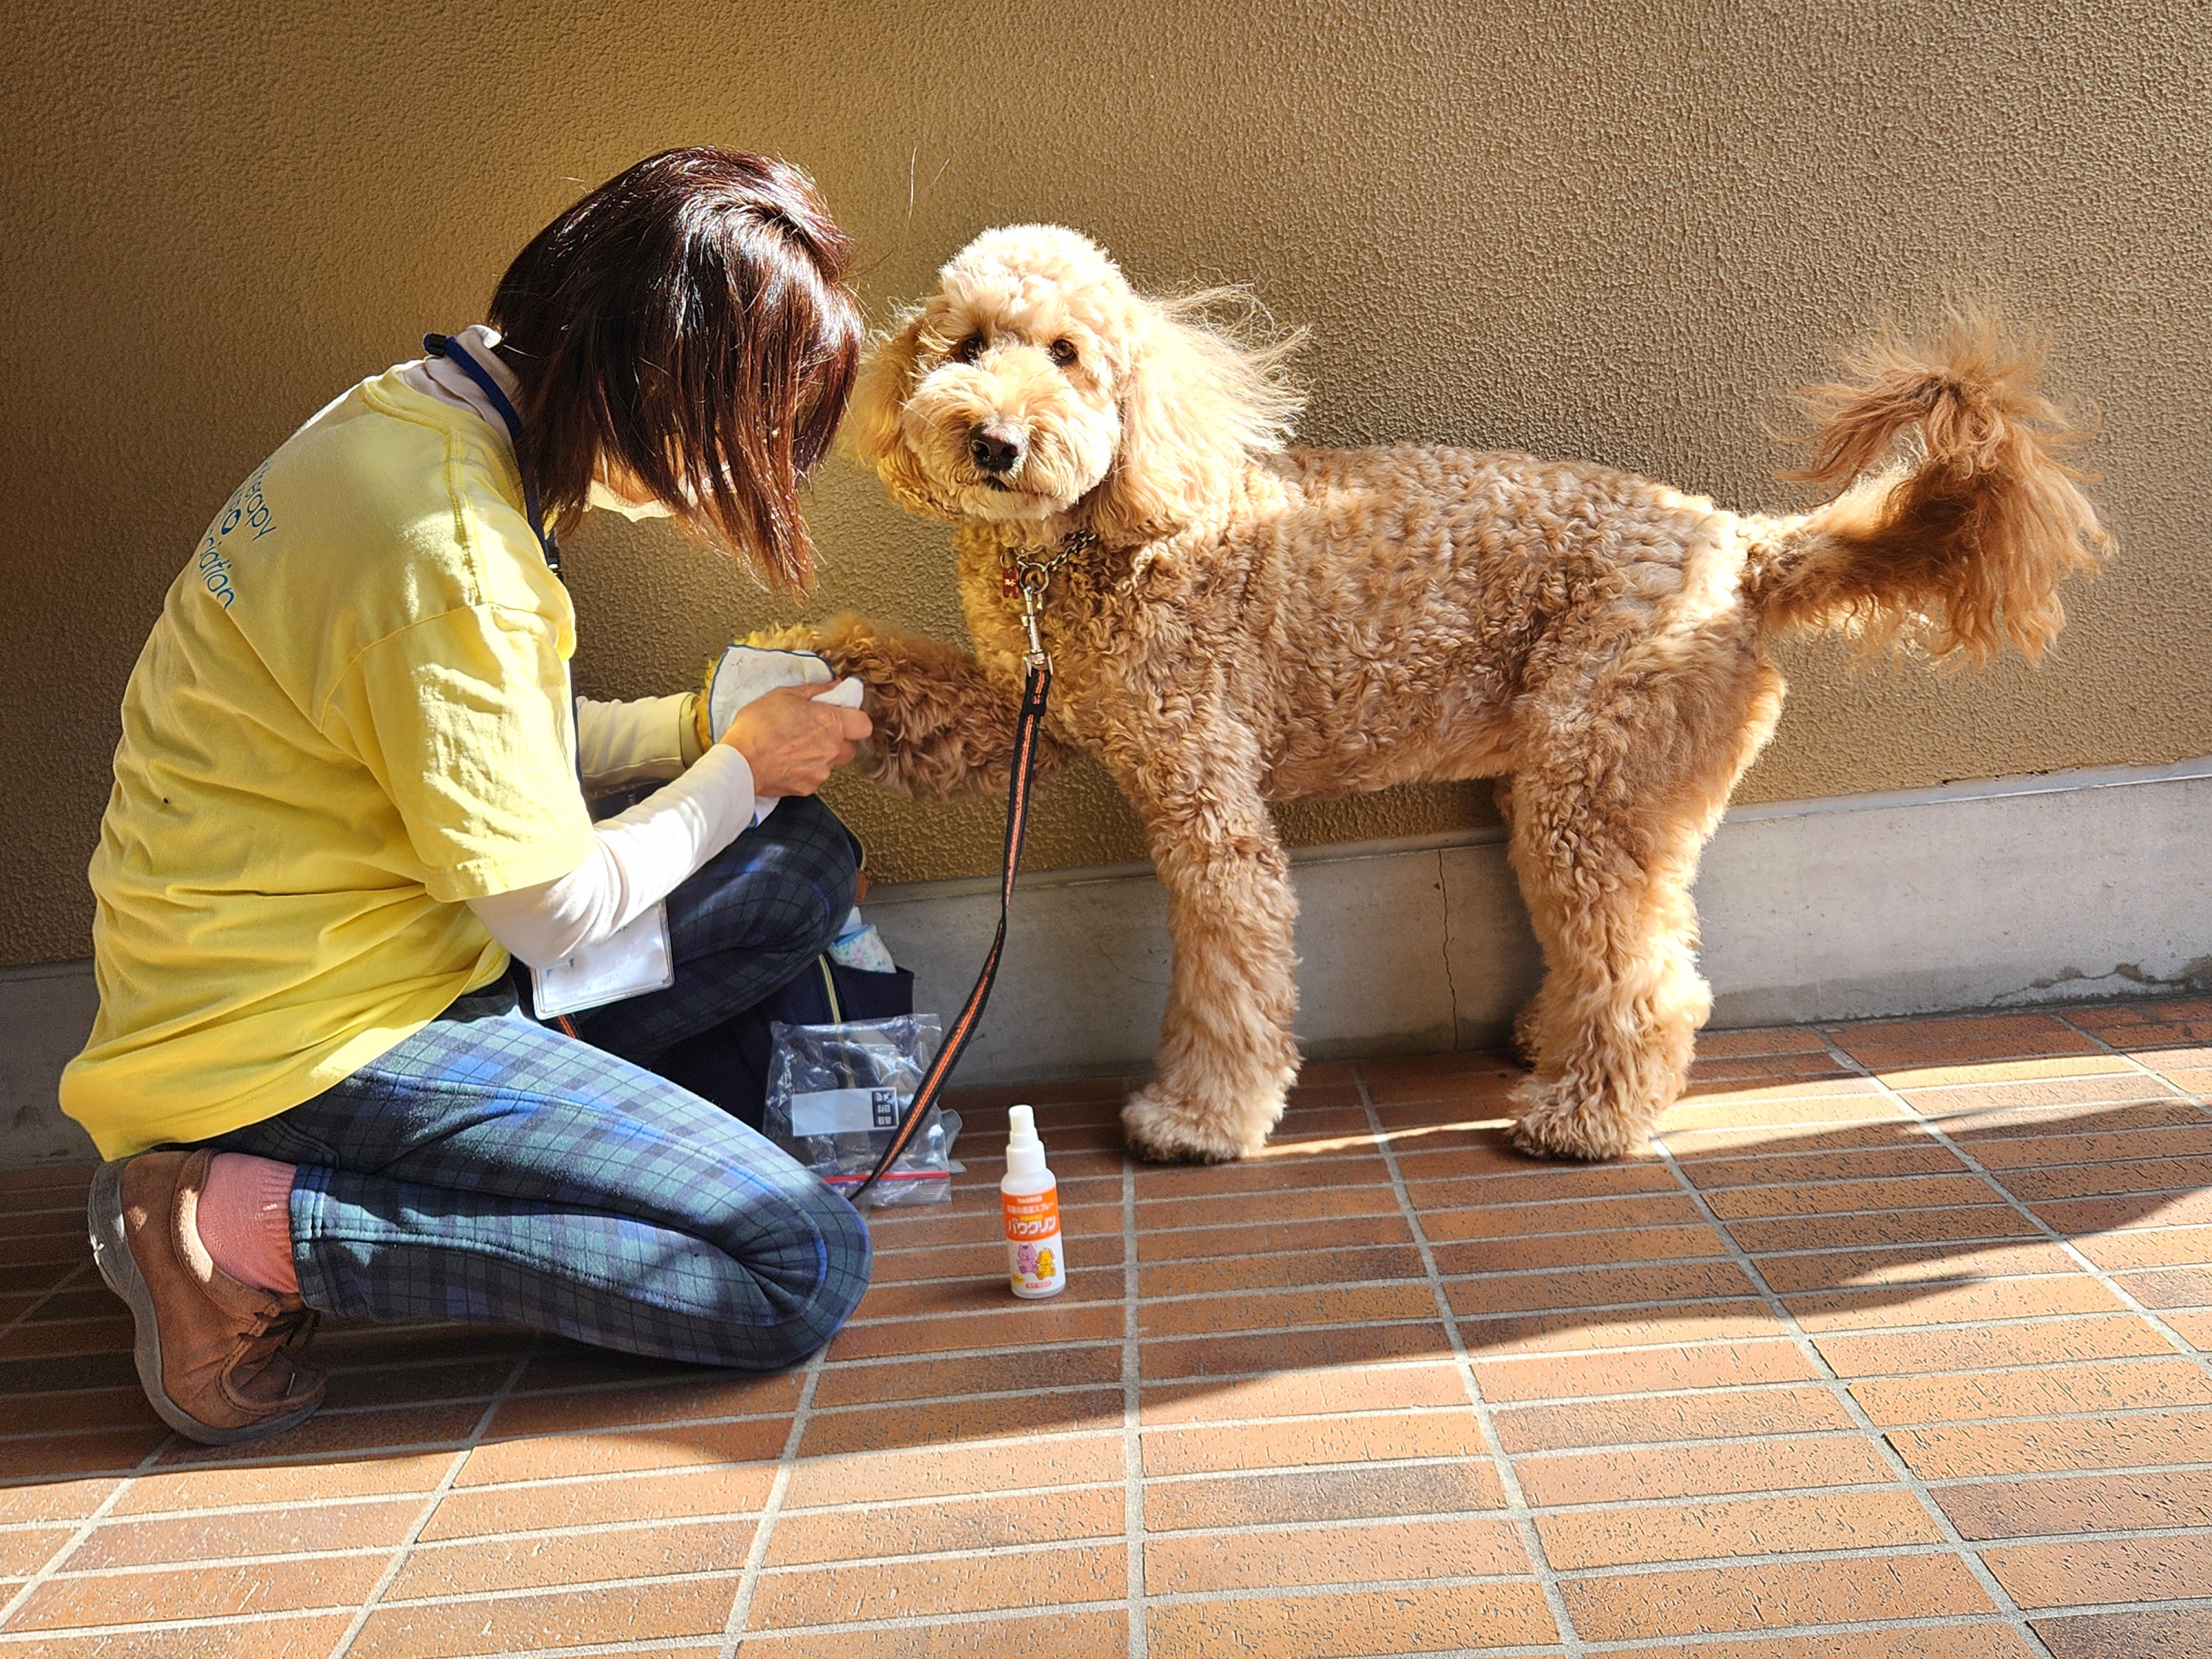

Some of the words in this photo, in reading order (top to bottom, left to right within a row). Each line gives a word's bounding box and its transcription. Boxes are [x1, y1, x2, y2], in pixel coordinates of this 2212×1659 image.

[1009, 1215, 1056, 1235] パウクリン
